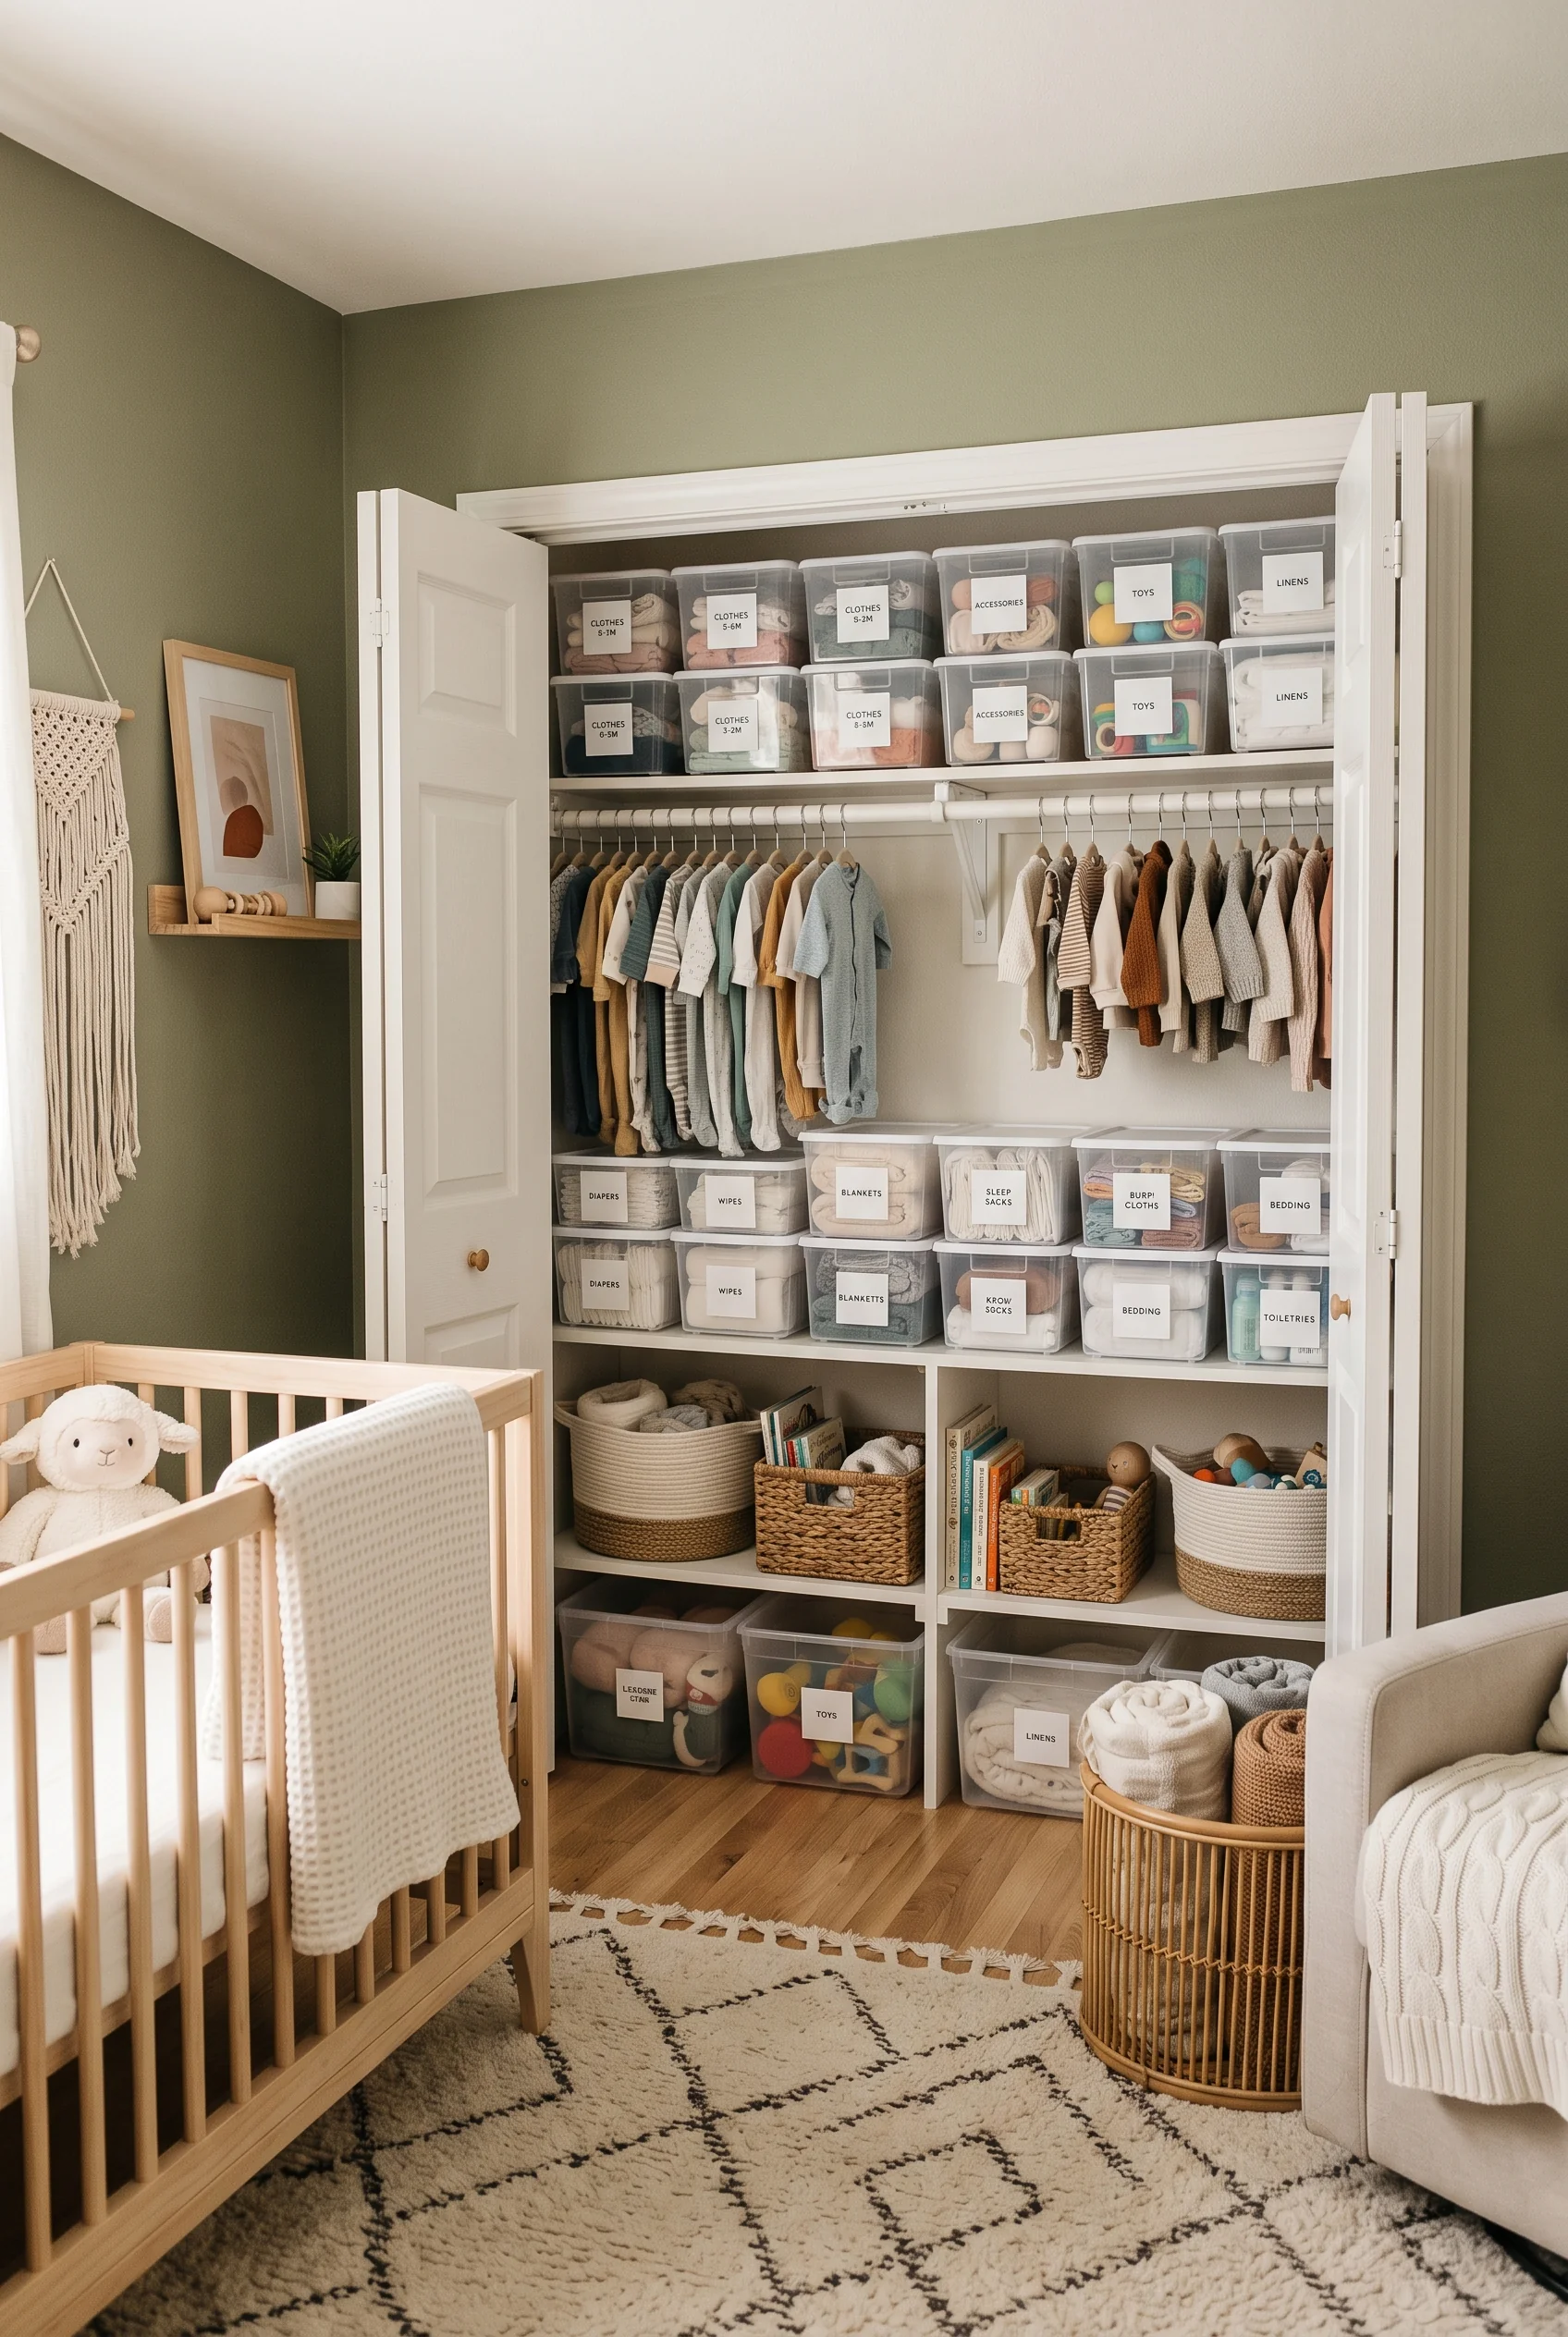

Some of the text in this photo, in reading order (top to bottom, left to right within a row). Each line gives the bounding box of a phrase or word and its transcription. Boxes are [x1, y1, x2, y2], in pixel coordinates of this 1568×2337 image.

[1277, 577, 1309, 587] LINENS
[1132, 588, 1155, 598] TOYS
[974, 598, 1024, 609] ACCESSORIES
[844, 604, 881, 614] CLOTHES
[714, 611, 749, 621] CLOTHES
[590, 618, 625, 628] CLOTHES
[1276, 691, 1308, 702] LINENS
[1132, 702, 1155, 711] TOYS
[846, 709, 882, 719] CLOTHES
[975, 709, 1024, 719] ACCESSORIES
[591, 720, 626, 729] CLOTHES
[715, 716, 750, 725] CLOTHES
[589, 1192, 619, 1201] DIAPERS
[841, 1189, 882, 1197] BLANKETS
[986, 1188, 1011, 1196] SLEEP
[717, 1197, 742, 1205] WIPES
[985, 1197, 1012, 1206] SACKS
[1124, 1201, 1159, 1210] CLOTHS
[1269, 1201, 1311, 1210] BEDDING
[589, 1279, 620, 1289] DIAPERS
[718, 1288, 742, 1296] WIPES
[838, 1293, 885, 1303] BLANKETTS
[986, 1296, 1012, 1304] KROW
[1122, 1306, 1161, 1315] BEDDING
[1263, 1314, 1316, 1324] TOILETRIES
[815, 1710, 838, 1719] TOYS
[1026, 1732, 1056, 1744] LINENS
